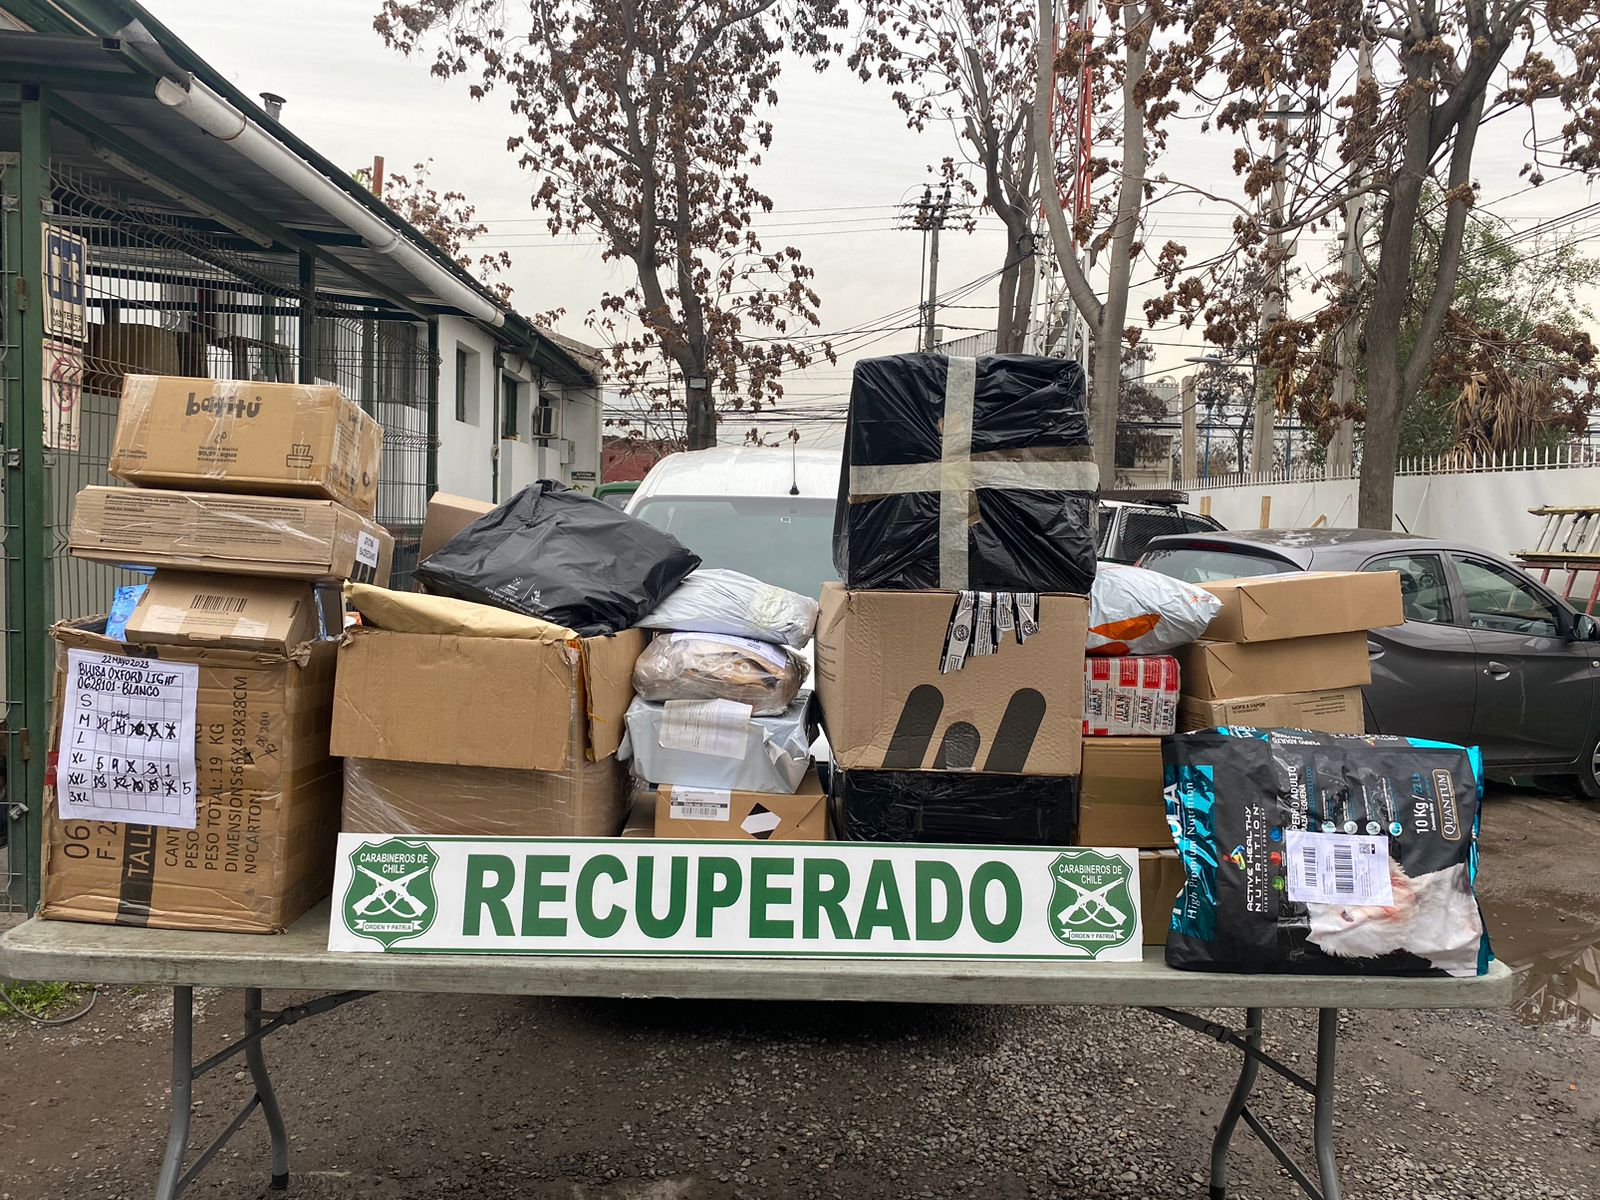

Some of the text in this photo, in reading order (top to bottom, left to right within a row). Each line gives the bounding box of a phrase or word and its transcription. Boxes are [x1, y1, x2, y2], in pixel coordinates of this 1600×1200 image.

[130, 659, 150, 669] 2023
[108, 665, 143, 684] OXFORD
[145, 672, 179, 686] LIGHT
[77, 676, 116, 692] 0628101
[121, 681, 160, 697] BLANCO
[80, 693, 93, 707] S
[1115, 694, 1125, 722] JUAN
[1140, 695, 1148, 724] JUAN
[79, 713, 91, 727] M
[76, 730, 86, 744] L
[71, 751, 87, 765] XL
[165, 764, 173, 778] 1
[68, 771, 88, 786] XXL
[1412, 783, 1424, 794] 22
[70, 791, 90, 804] 3XL
[204, 723, 225, 871] PESO TOTAL: 19 KG
[1287, 765, 1300, 831] PERRO ADULTO
[1437, 774, 1457, 835] QUANTUM
[1186, 782, 1196, 836] Nutrition
[1413, 801, 1429, 817] Kg
[1415, 819, 1430, 834] 10
[63, 821, 91, 859] 06
[96, 821, 118, 860] F-2
[184, 830, 200, 869] PESO
[127, 825, 153, 877] TALL
[360, 853, 429, 864] CARABINEROS DE
[1245, 806, 1254, 912] ACTIVE HEALTHY
[1253, 805, 1262, 913] NUTRITION
[382, 864, 406, 874] CHILE
[1058, 863, 1123, 875] CARABINEROS DE
[1081, 875, 1103, 885] CHILE
[462, 853, 1024, 944] RECUPERADO
[1187, 891, 1200, 920] High
[1070, 932, 1090, 940] ORDEN
